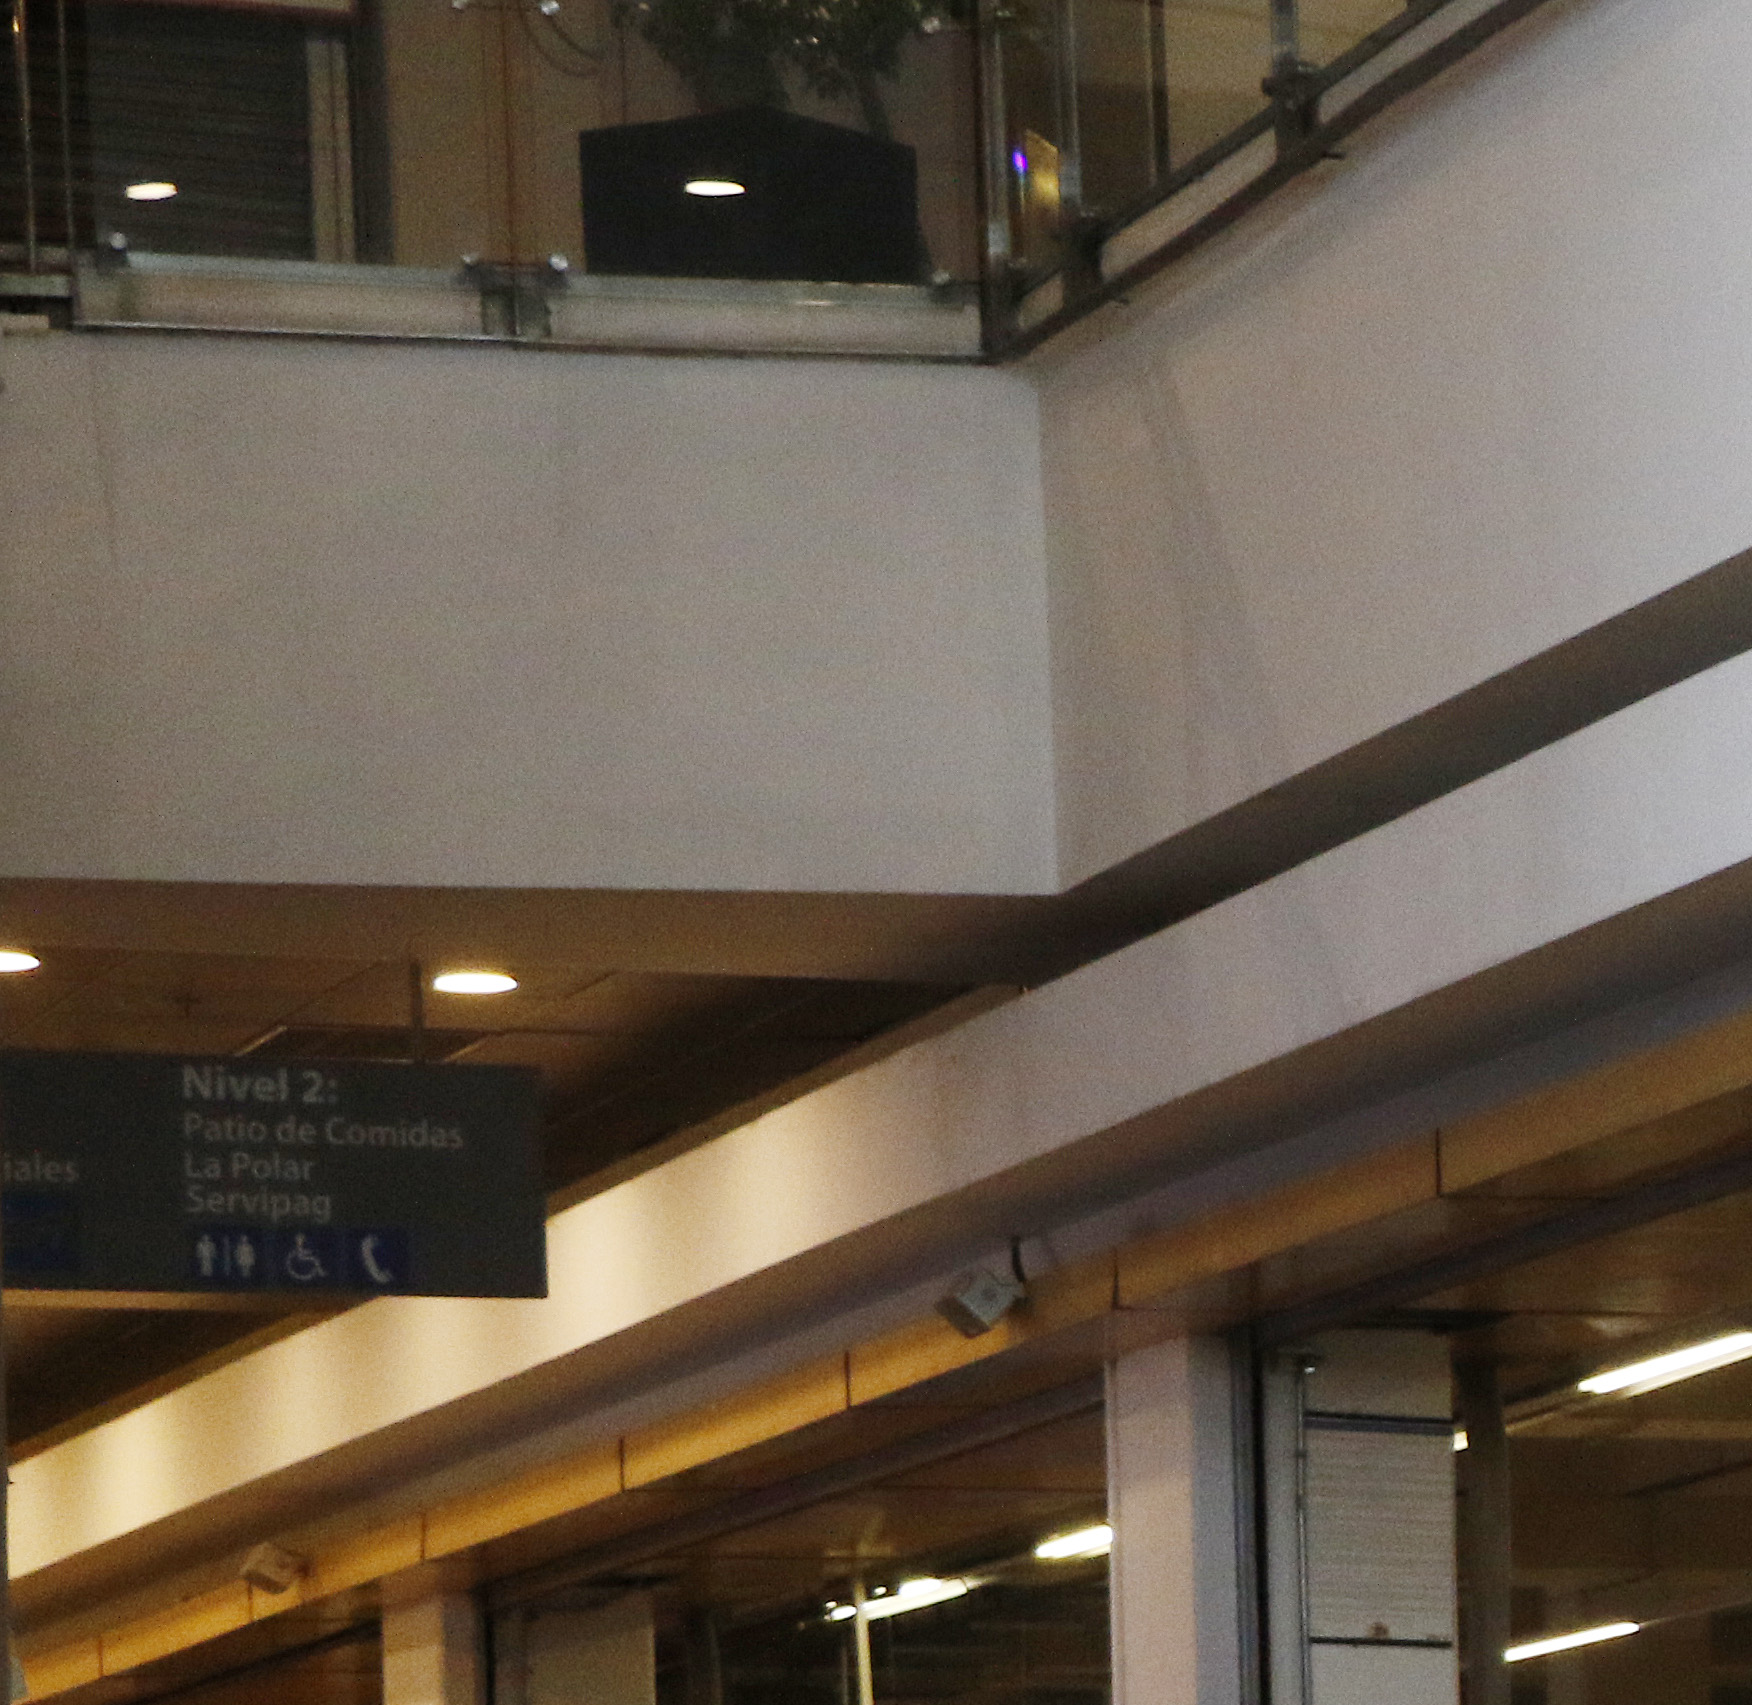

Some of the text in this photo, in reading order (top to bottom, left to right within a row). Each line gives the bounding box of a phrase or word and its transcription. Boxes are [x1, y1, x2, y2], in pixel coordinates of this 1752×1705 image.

[181, 1065, 338, 1103] Nivel 2:
[184, 1112, 464, 1150] Patio de Comidas
[185, 1151, 313, 1181] La Polar
[185, 1184, 333, 1223] Servipag
